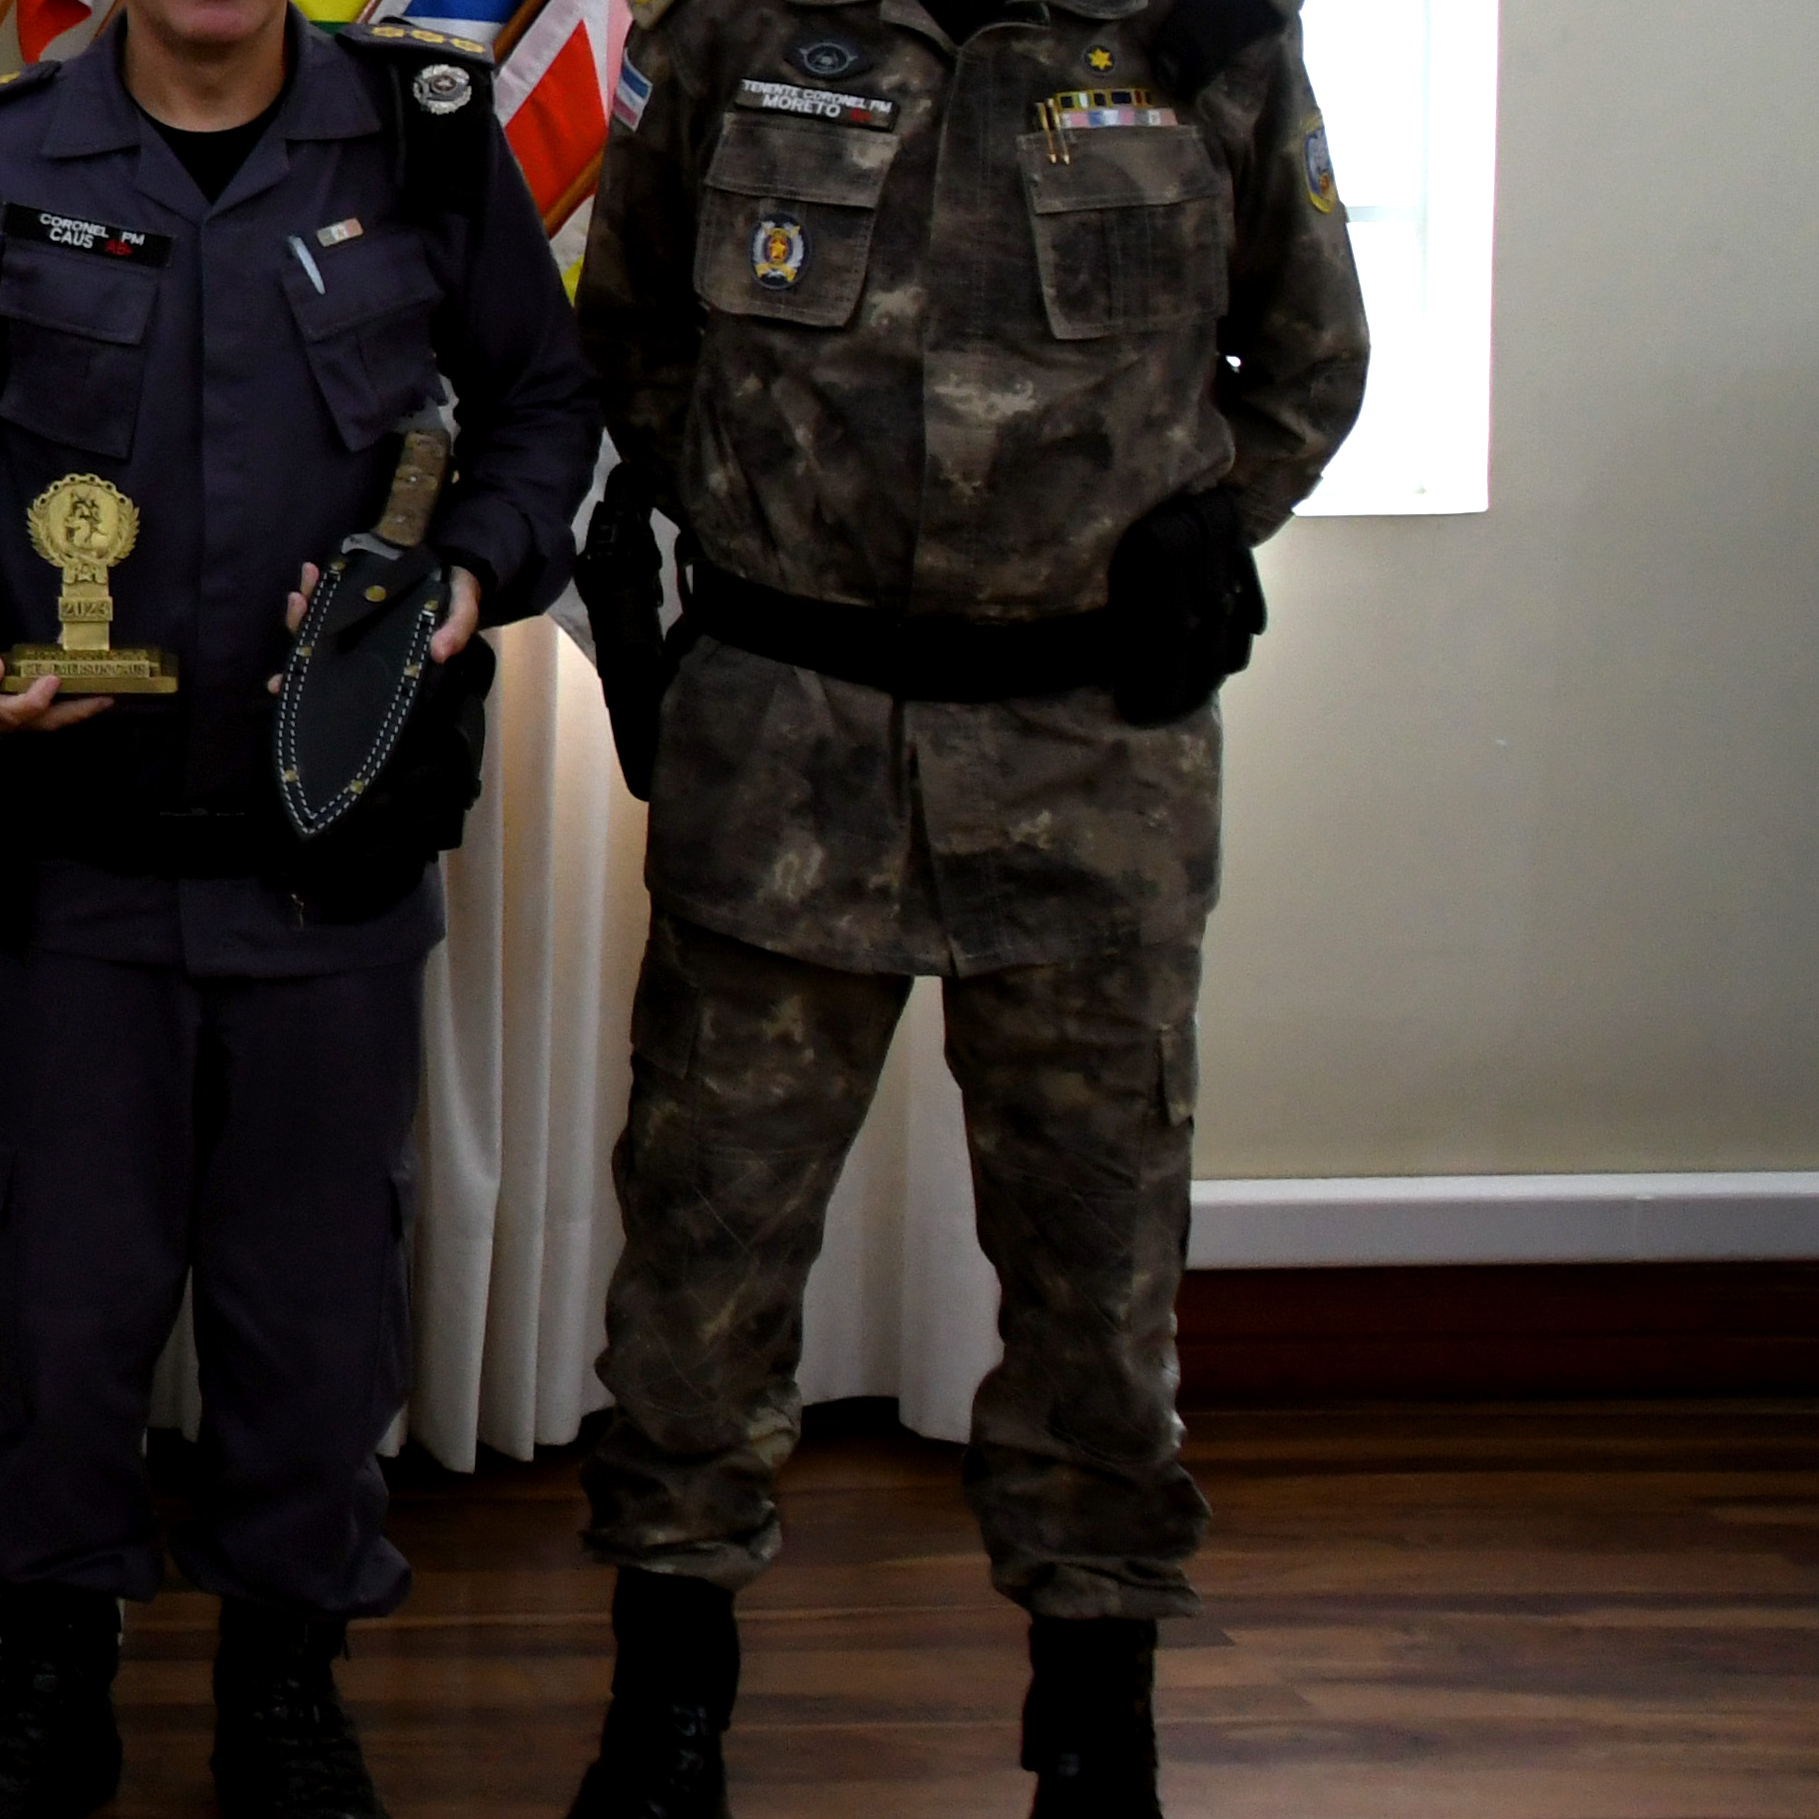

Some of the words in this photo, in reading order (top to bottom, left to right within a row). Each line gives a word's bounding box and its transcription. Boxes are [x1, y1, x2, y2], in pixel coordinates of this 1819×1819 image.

[741, 79, 802, 98] TENENTE
[803, 89, 867, 109] CORONEL
[869, 100, 893, 114] PM
[762, 94, 841, 118] MORETO
[39, 213, 110, 239] CORONEL
[121, 231, 146, 246] PM
[49, 228, 94, 249] CAUS
[63, 602, 108, 616] 2023
